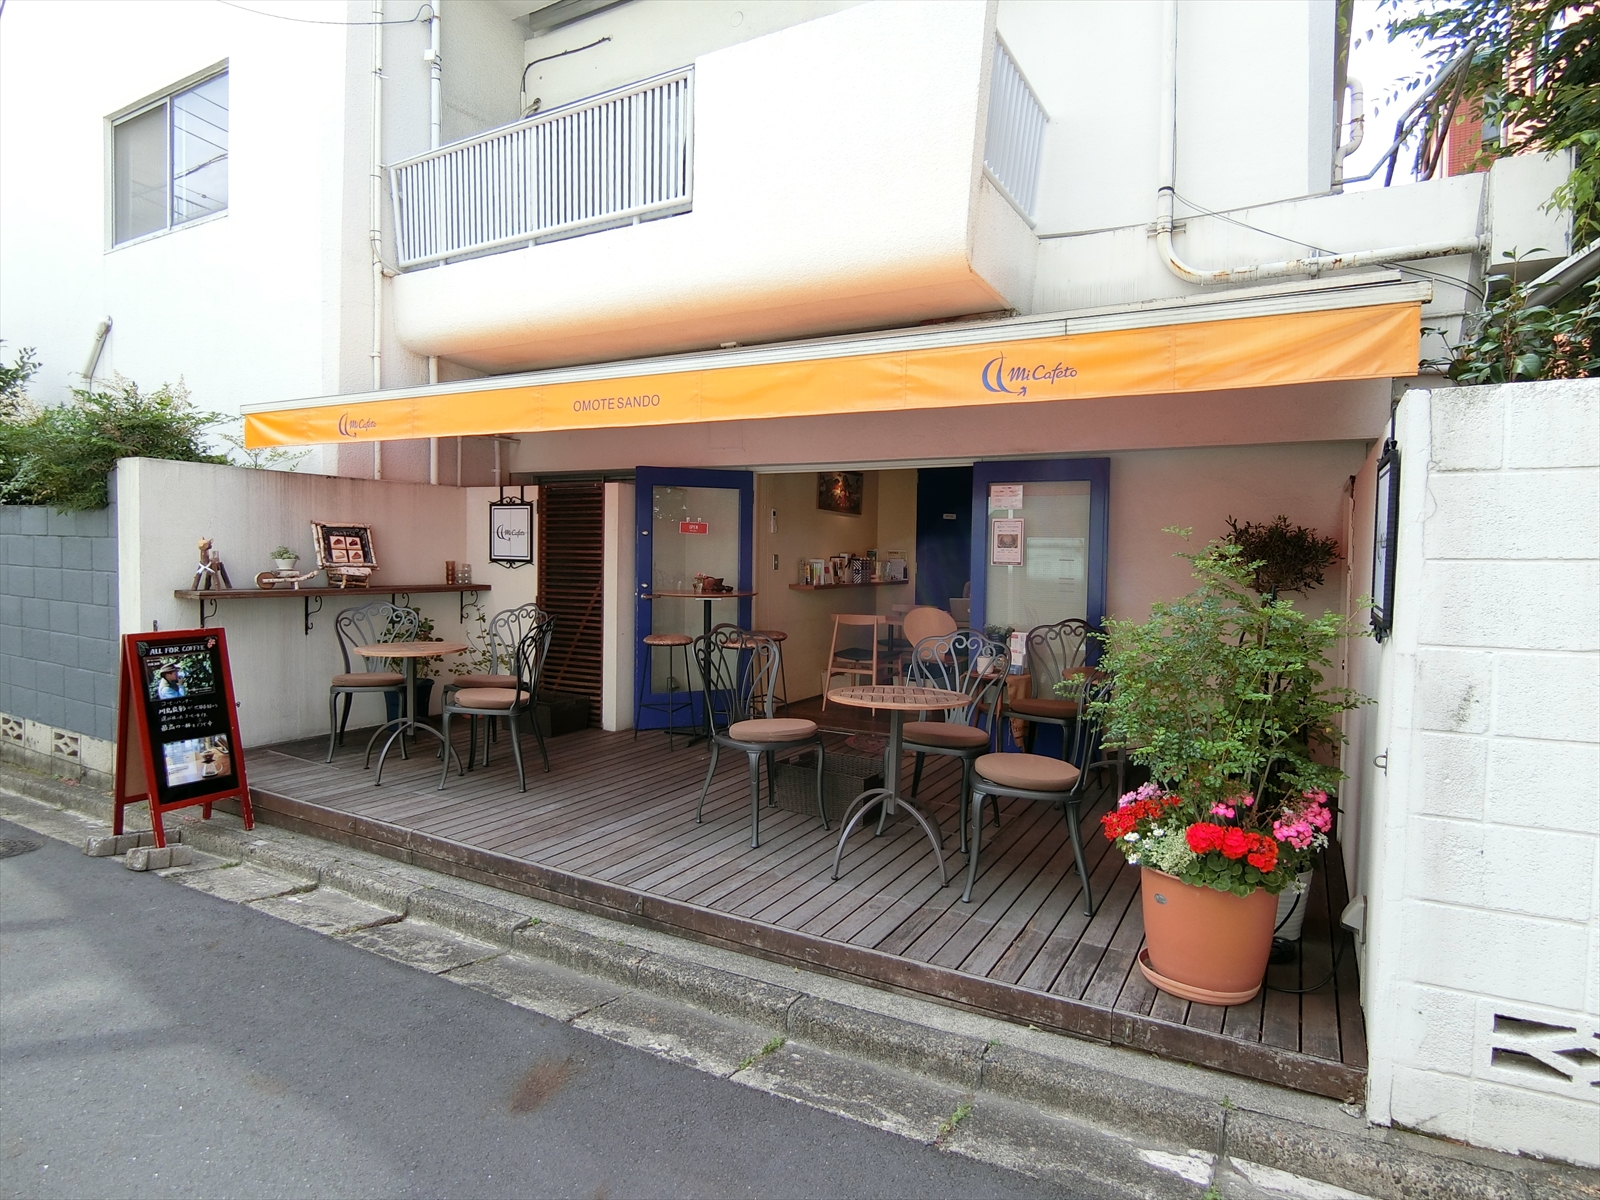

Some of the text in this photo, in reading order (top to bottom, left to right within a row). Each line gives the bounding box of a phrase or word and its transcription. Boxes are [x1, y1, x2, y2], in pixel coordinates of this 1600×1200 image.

[1032, 361, 1078, 385] Cafeto
[149, 648, 163, 656] ALL
[164, 646, 180, 654] FOR
